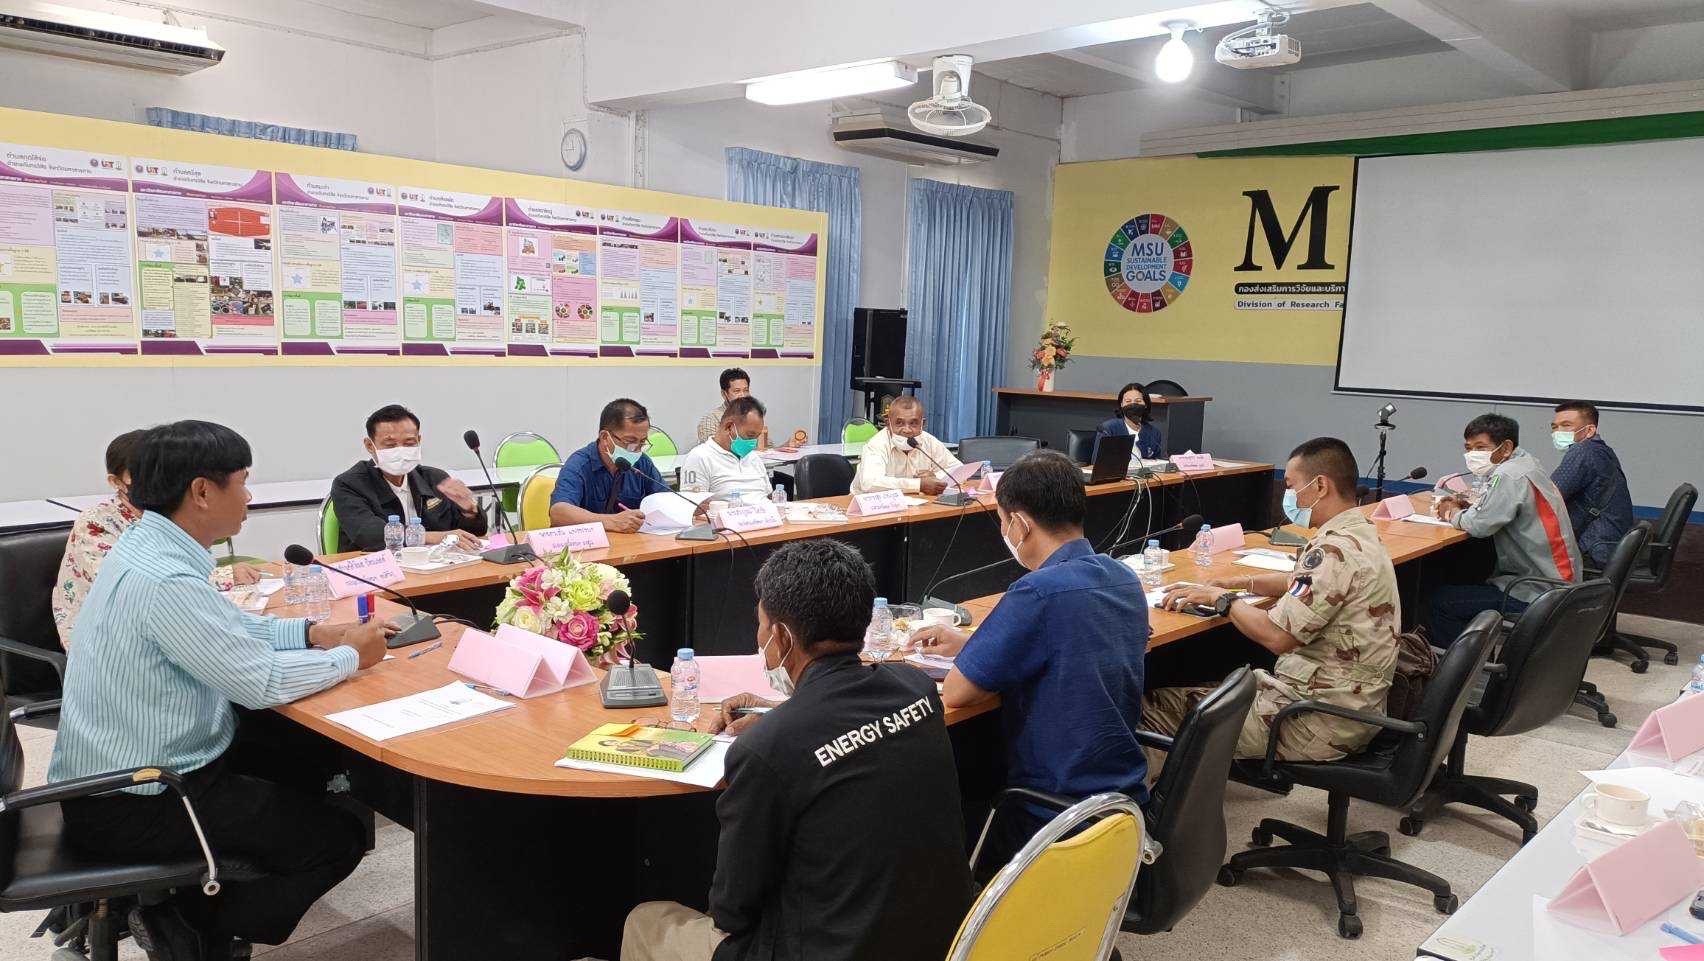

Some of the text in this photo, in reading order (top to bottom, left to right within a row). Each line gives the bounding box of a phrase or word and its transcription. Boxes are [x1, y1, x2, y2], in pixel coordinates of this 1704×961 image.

[1234, 185, 1340, 271] M
[1131, 241, 1164, 256] MSU
[1126, 256, 1167, 264] SUSTAINABLE
[1126, 271, 1167, 282] GOALS
[1237, 300, 1272, 308] Division
[1290, 301, 1330, 309] Research
[814, 695, 934, 768] ENERGY SAFETY
